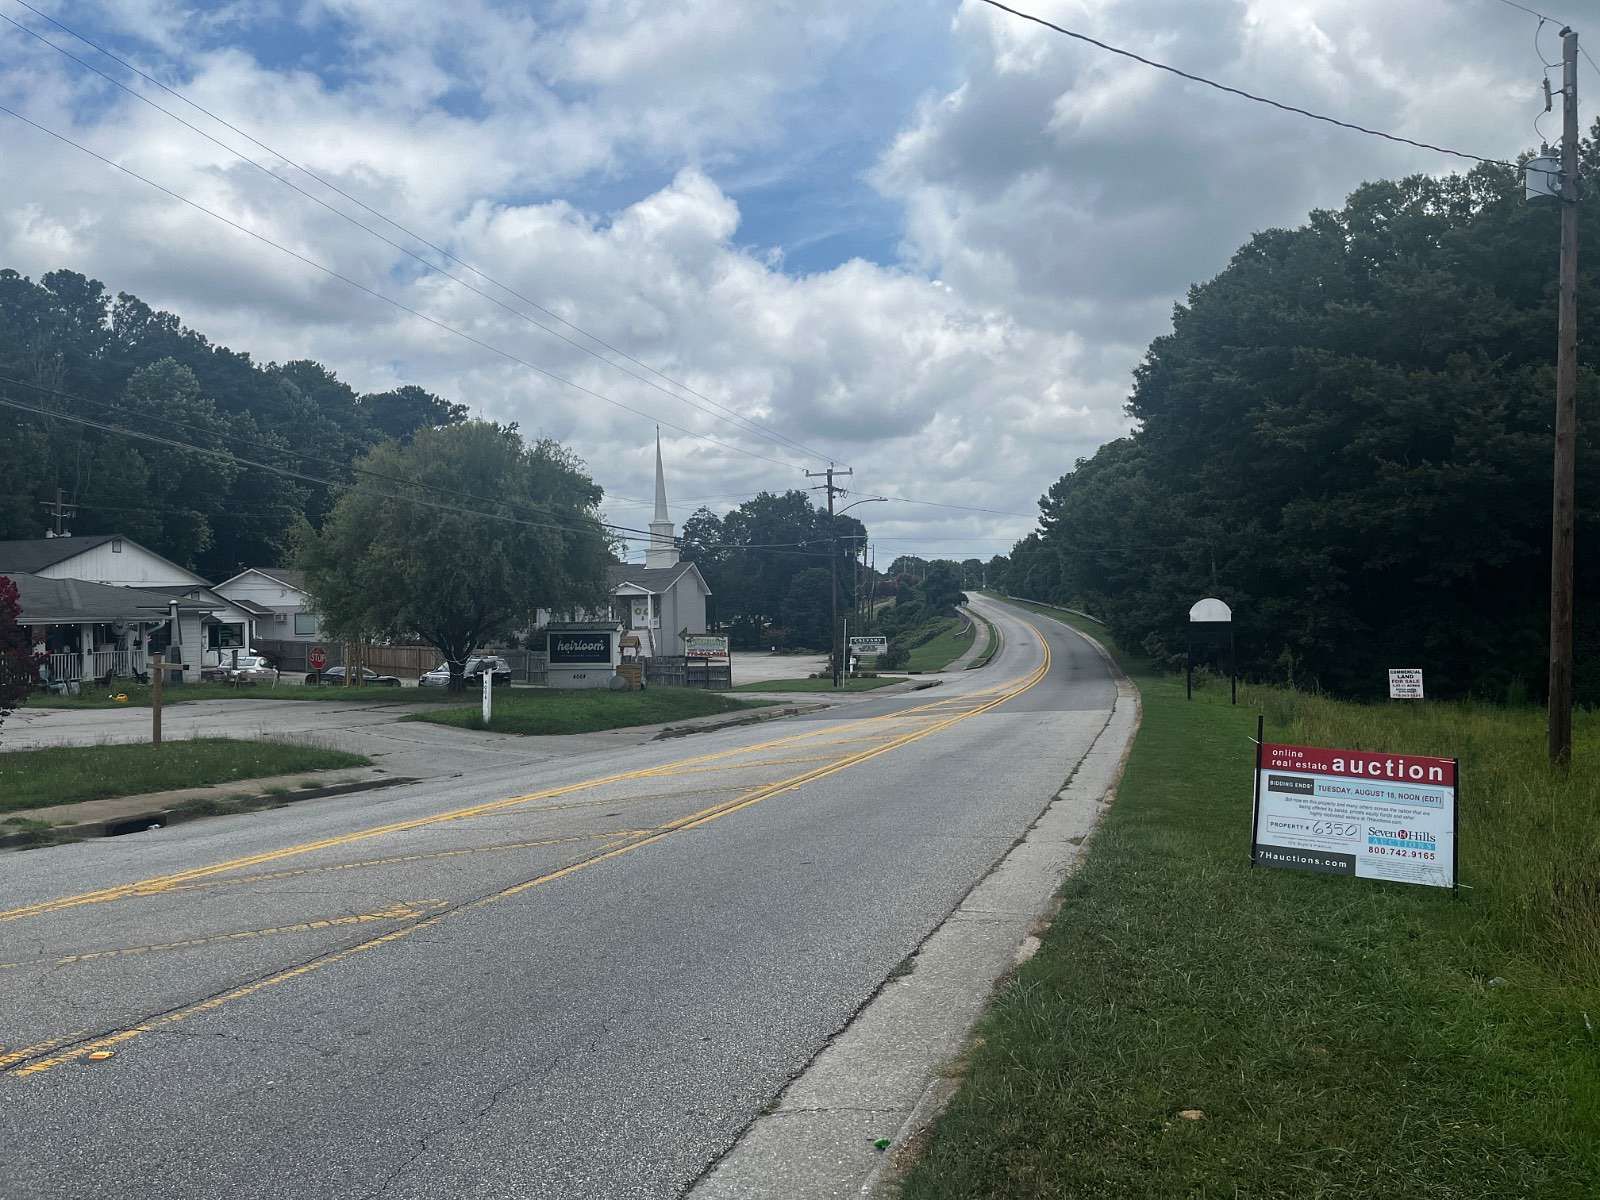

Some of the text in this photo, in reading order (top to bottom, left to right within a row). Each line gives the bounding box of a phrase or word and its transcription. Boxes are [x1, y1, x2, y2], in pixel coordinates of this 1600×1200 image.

[557, 639, 606, 654] heirloom
[310, 653, 325, 662] STOP
[1272, 749, 1303, 758] online
[1272, 758, 1443, 781] real estate auction
[1355, 788, 1384, 797] AUGUST
[1398, 792, 1420, 801] NOON
[1422, 794, 1442, 804] (EDT)
[1270, 821, 1303, 830] PROPERTY
[1312, 819, 1358, 836] 6350
[1368, 827, 1397, 838] Seven
[1409, 831, 1436, 842] Hills
[1258, 851, 1347, 868] 7Hauctions.com
[1368, 846, 1435, 860] 800.742.9165
